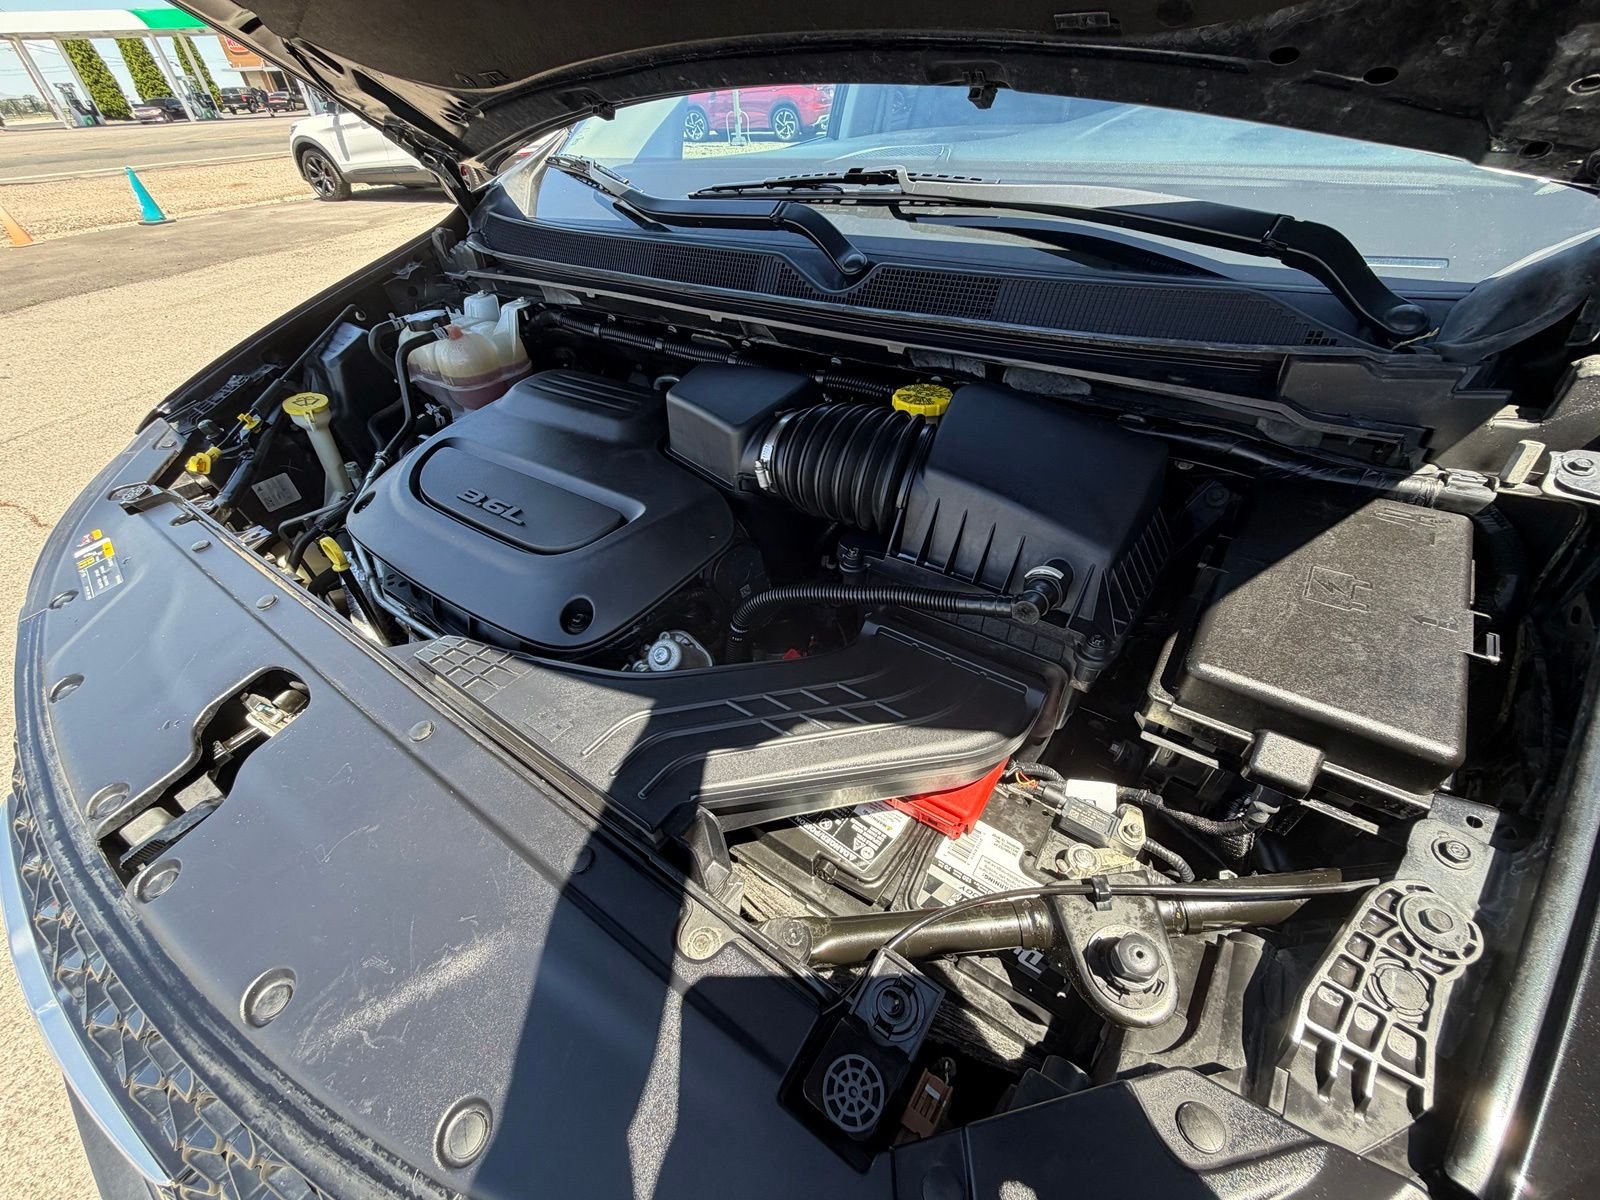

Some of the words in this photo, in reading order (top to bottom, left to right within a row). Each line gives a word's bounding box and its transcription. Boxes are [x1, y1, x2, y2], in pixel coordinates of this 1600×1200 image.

[456, 488, 525, 526] 3.6L
[795, 816, 851, 857] DANGER/POISON
[982, 873, 1009, 890] ARNING:
